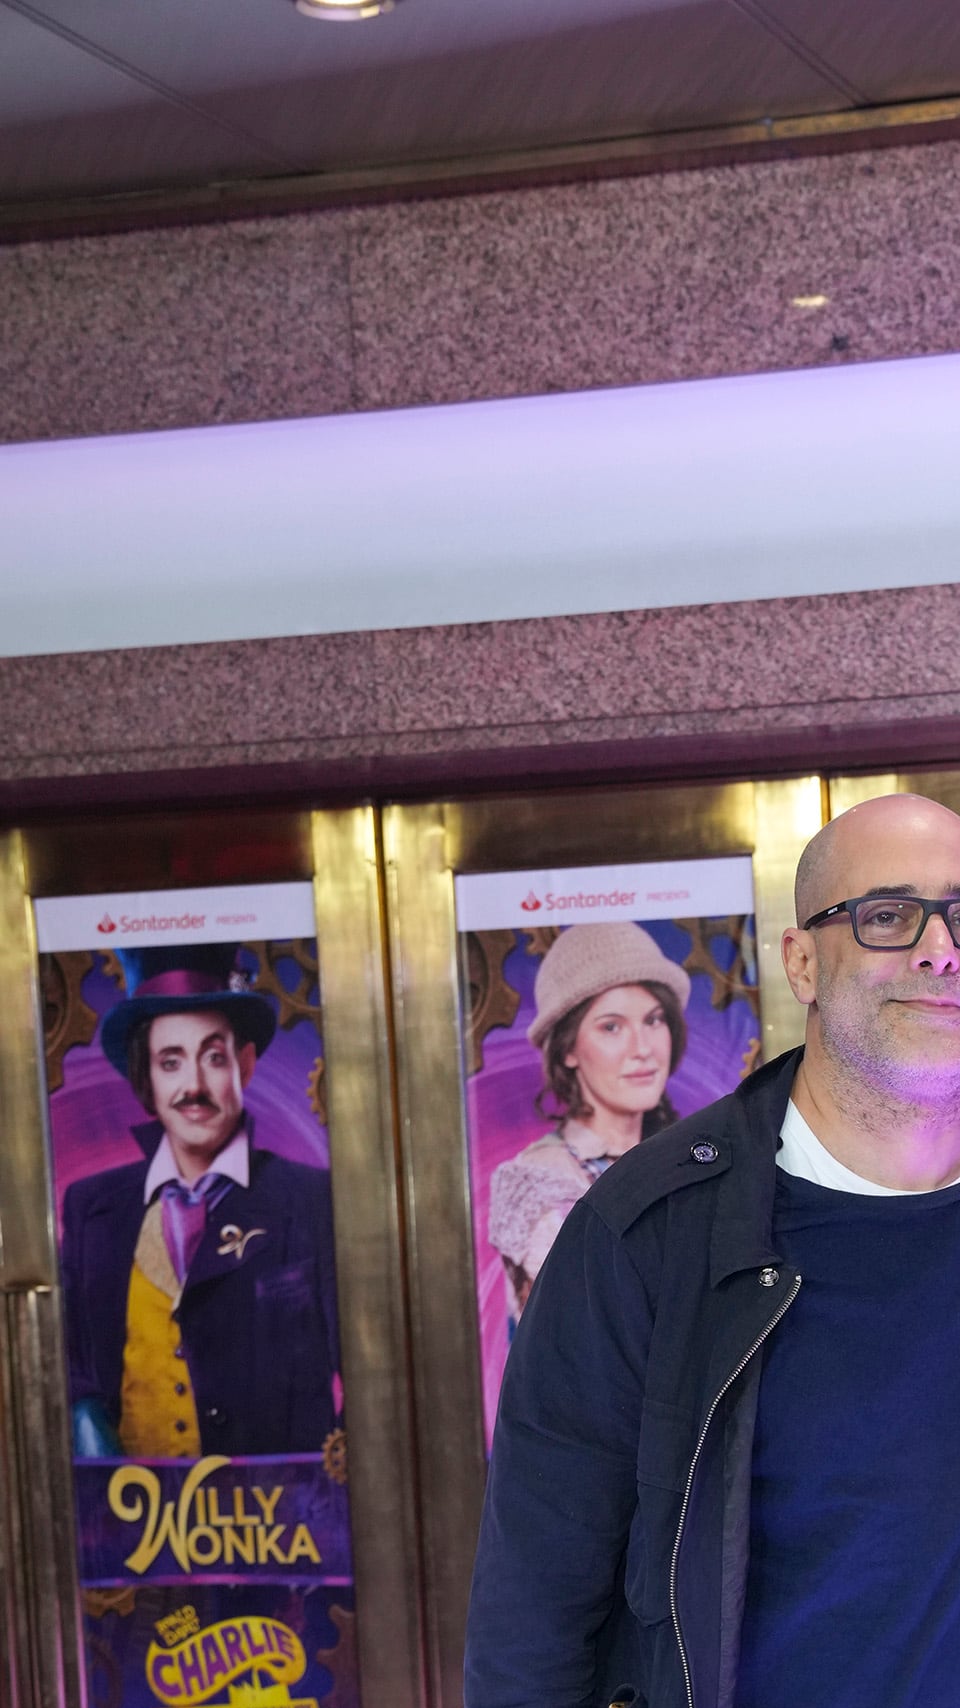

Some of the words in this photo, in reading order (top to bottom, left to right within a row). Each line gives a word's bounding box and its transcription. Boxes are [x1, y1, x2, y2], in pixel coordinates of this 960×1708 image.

[119, 914, 206, 934] Santander
[544, 888, 637, 912] Santander
[108, 1455, 284, 1550] WILLY
[151, 1622, 295, 1697] CHARLIE
